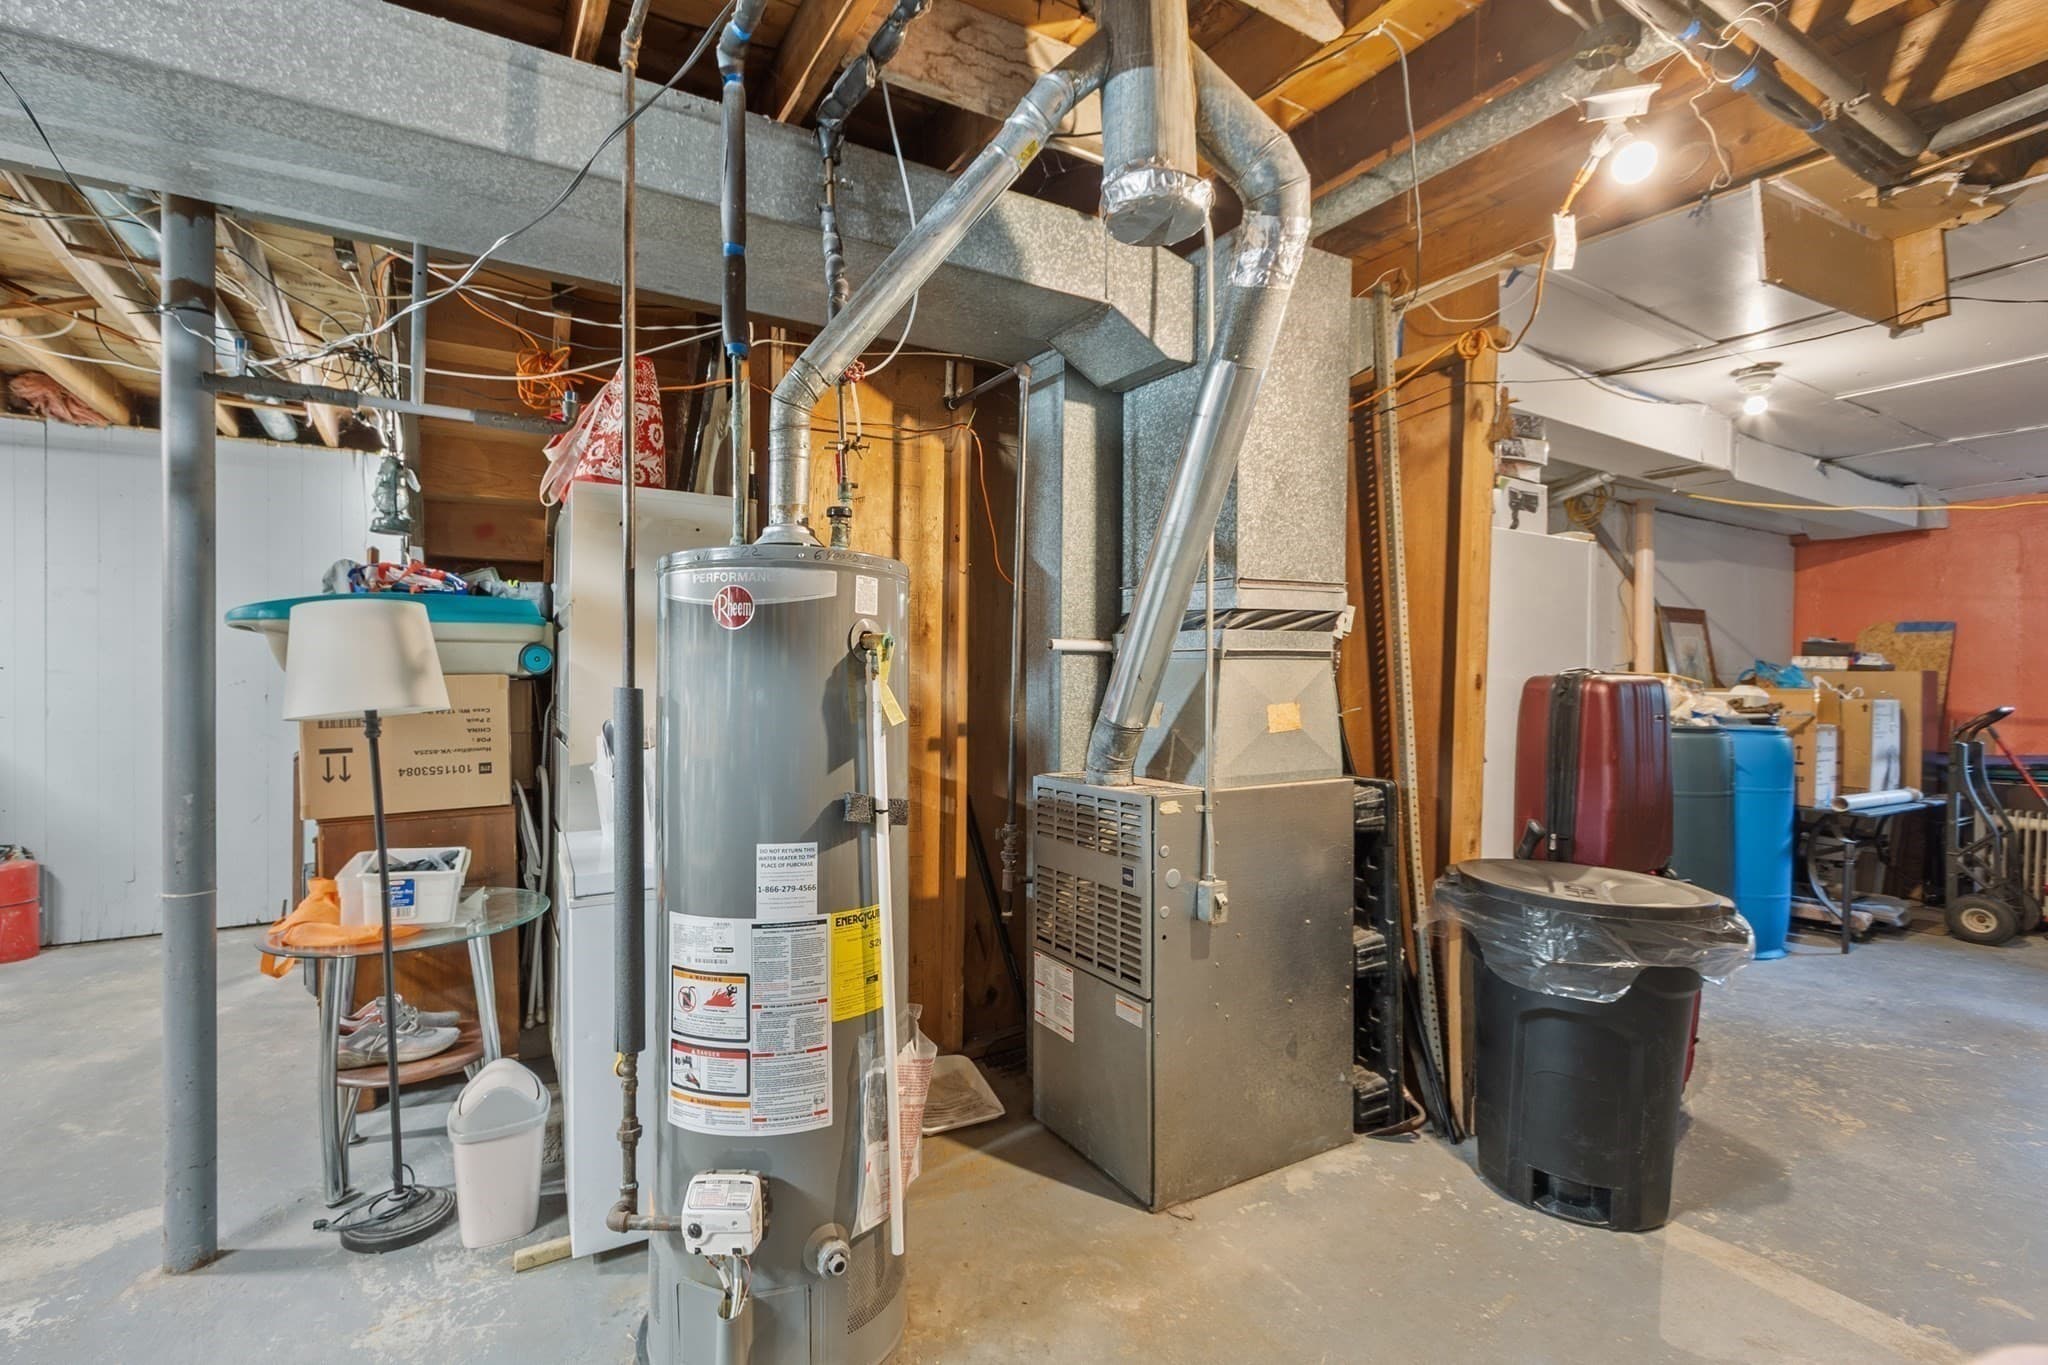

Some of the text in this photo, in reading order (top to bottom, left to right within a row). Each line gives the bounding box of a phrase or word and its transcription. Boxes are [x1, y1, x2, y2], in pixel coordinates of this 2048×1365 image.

[692, 571, 774, 584] PERFORMAN
[717, 587, 752, 627] Rheem
[398, 763, 472, 777] 1011553084
[758, 884, 816, 893] 1-866-279-4566
[835, 908, 880, 928] ENERGYGUI
